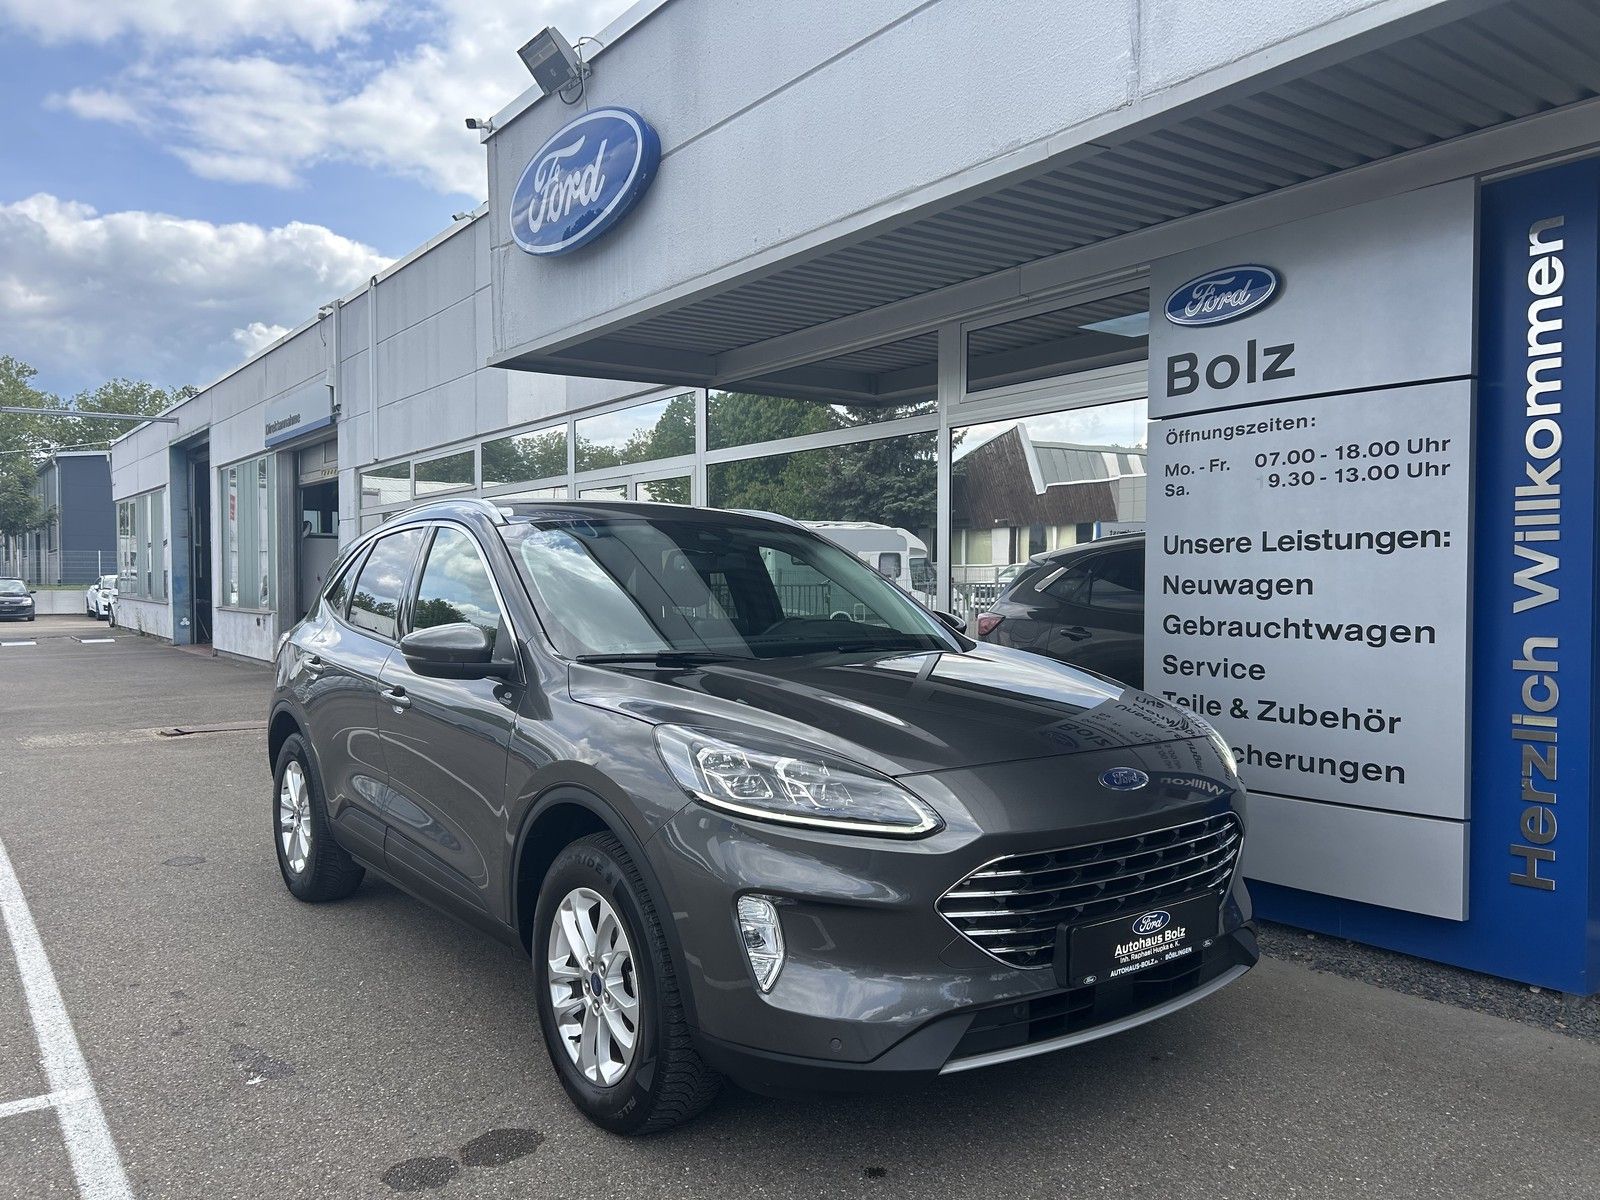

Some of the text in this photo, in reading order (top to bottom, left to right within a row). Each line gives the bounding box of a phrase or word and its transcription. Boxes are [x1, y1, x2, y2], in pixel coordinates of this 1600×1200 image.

[528, 135, 608, 233] Ford
[1184, 276, 1253, 317] Ford
[1167, 339, 1295, 397] Bolz
[1166, 417, 1316, 445] Öffnungszeiten:
[1165, 463, 1195, 477] Mo.
[1209, 458, 1230, 472] Fr.
[1255, 448, 1315, 467] 07.00
[1335, 440, 1400, 460] 18.00
[1407, 437, 1451, 455] Uhr
[1165, 484, 1190, 497] Sa.
[1268, 470, 1315, 488] 9.30
[1334, 464, 1400, 483] 13.00
[1407, 461, 1451, 478] Uhr
[1164, 529, 1451, 555] Unsere Leistungen:
[1510, 215, 1565, 891] Herzlich Willkommen
[1163, 575, 1314, 600] Neuwagen
[1163, 614, 1436, 648] Gebrauchtwagen
[1163, 654, 1266, 681] Service
[1163, 691, 1222, 717] Teile
[1229, 698, 1250, 720] &
[1257, 699, 1402, 734] Zubehör
[1231, 744, 1406, 785] cherungen
[1139, 914, 1163, 932] Ford
[1114, 926, 1186, 957] Autohaus Bolz
